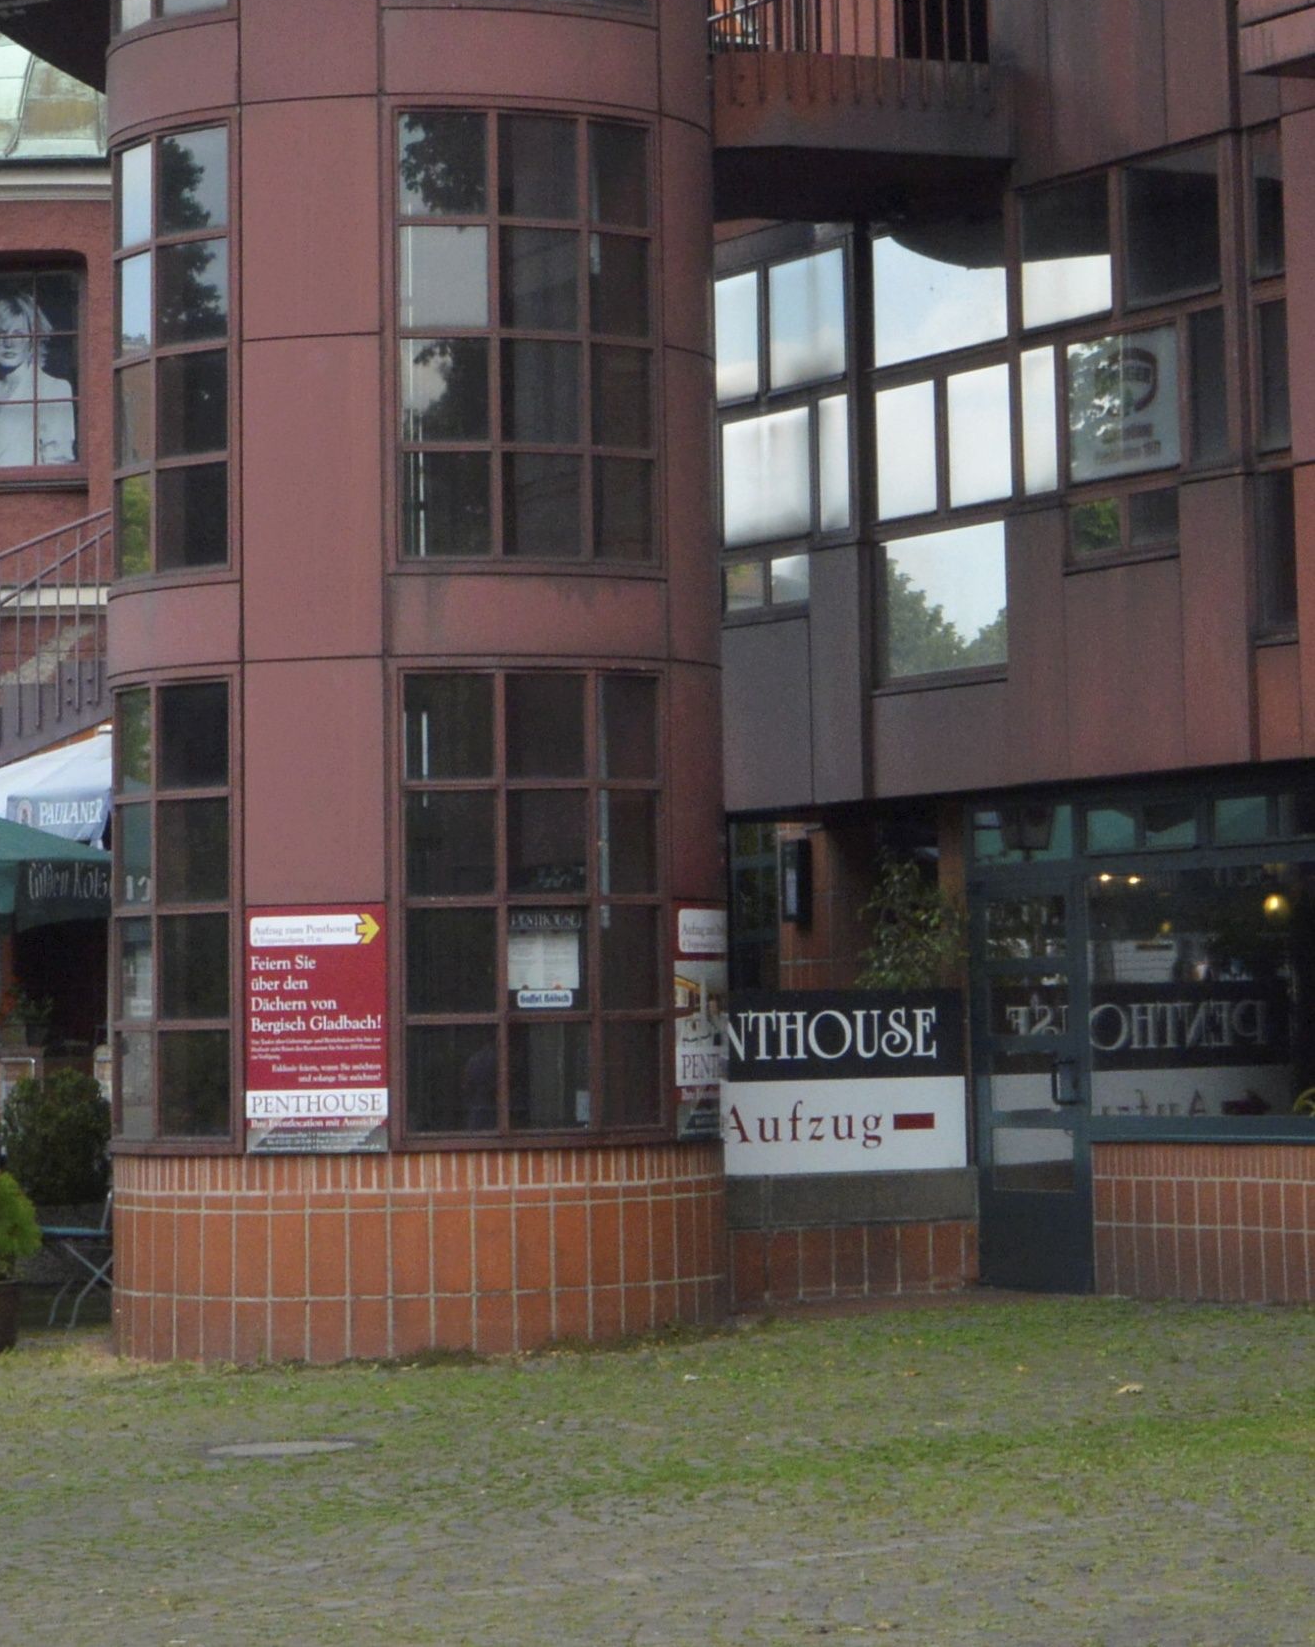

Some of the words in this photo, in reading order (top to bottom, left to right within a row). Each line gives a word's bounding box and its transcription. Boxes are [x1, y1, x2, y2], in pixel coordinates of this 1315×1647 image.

[39, 798, 103, 827] PAULANER
[28, 861, 69, 900] Gilden
[250, 956, 291, 971] Feiern
[295, 954, 317, 970] Sie
[251, 976, 280, 991] über
[283, 975, 309, 990] den
[251, 996, 307, 1012] Dächern
[311, 999, 337, 1010] von
[251, 1016, 306, 1034] Bergisch
[309, 1014, 382, 1031] Gladbach!
[727, 1007, 937, 1061] NTHOUSE
[251, 1094, 383, 1113] PENTHOUSE
[723, 1100, 882, 1149] Aufzug
